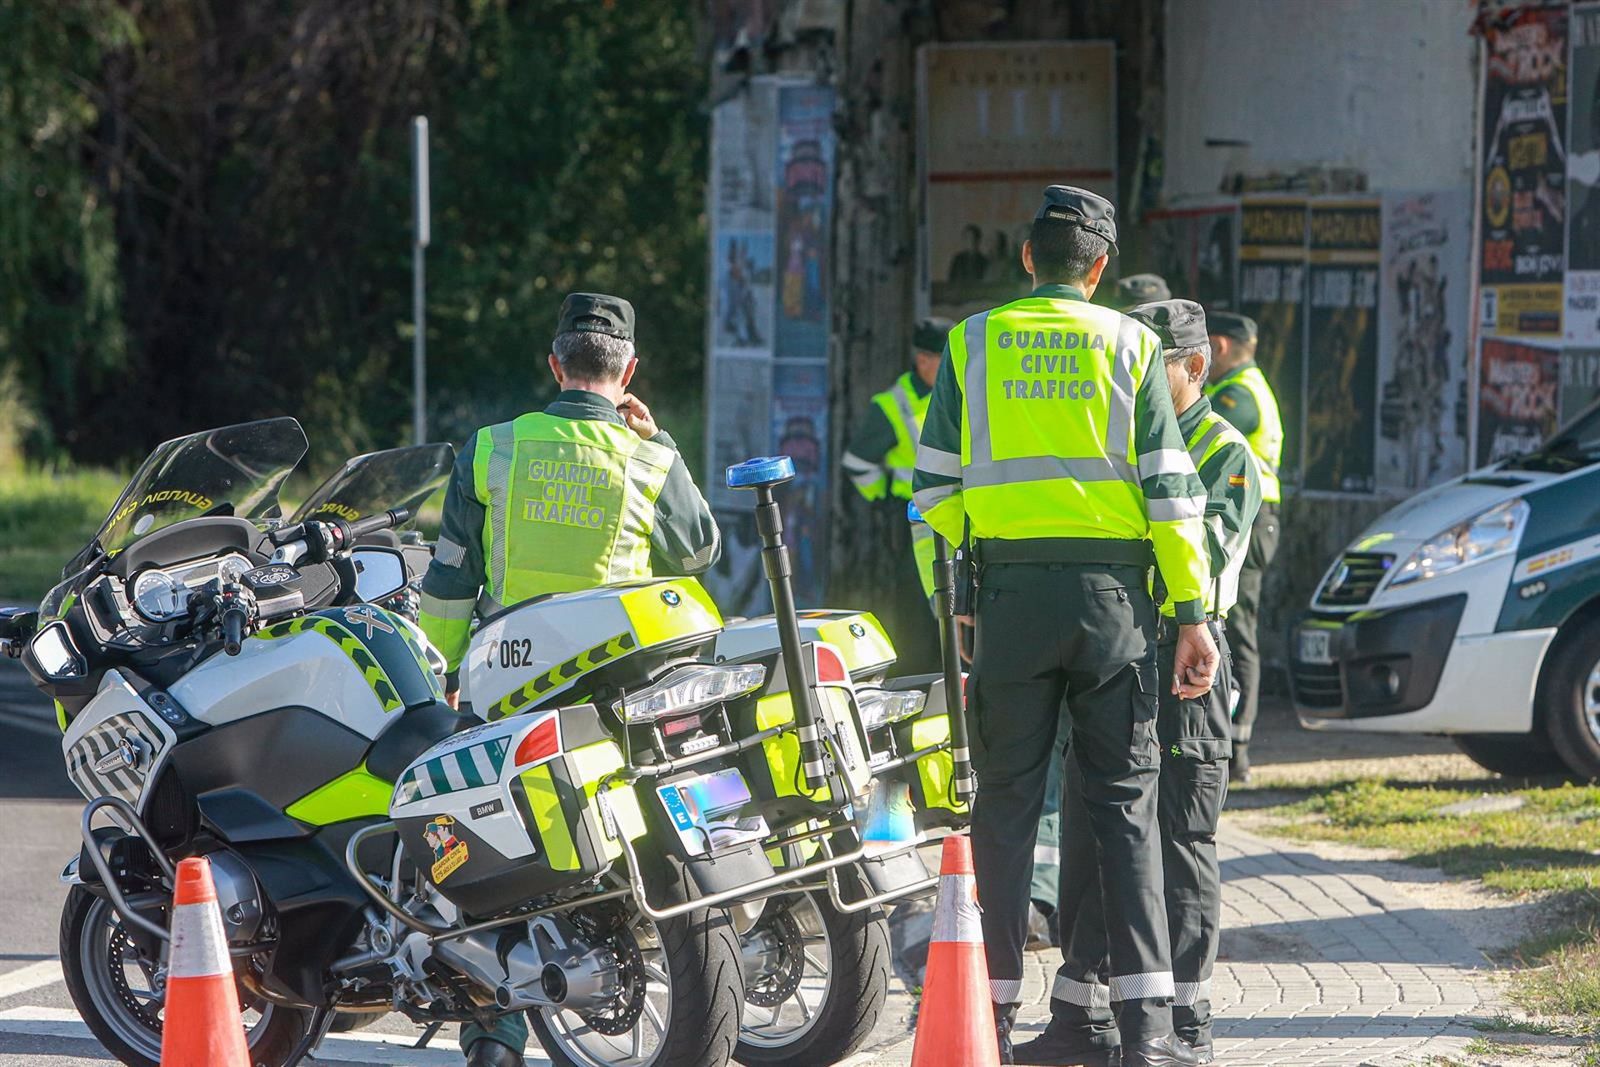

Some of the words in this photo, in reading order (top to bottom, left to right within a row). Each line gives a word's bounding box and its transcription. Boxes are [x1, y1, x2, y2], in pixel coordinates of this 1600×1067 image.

[997, 330, 1105, 351] GUARDIA
[1020, 354, 1080, 374] CIVIL
[1002, 379, 1097, 401] TRAFICO
[528, 460, 610, 489] GUARDIA
[542, 481, 592, 506] CIVIL
[525, 500, 604, 529] TRAFICO
[500, 638, 532, 669] 062
[476, 804, 494, 816] BMW
[675, 812, 688, 824] E
